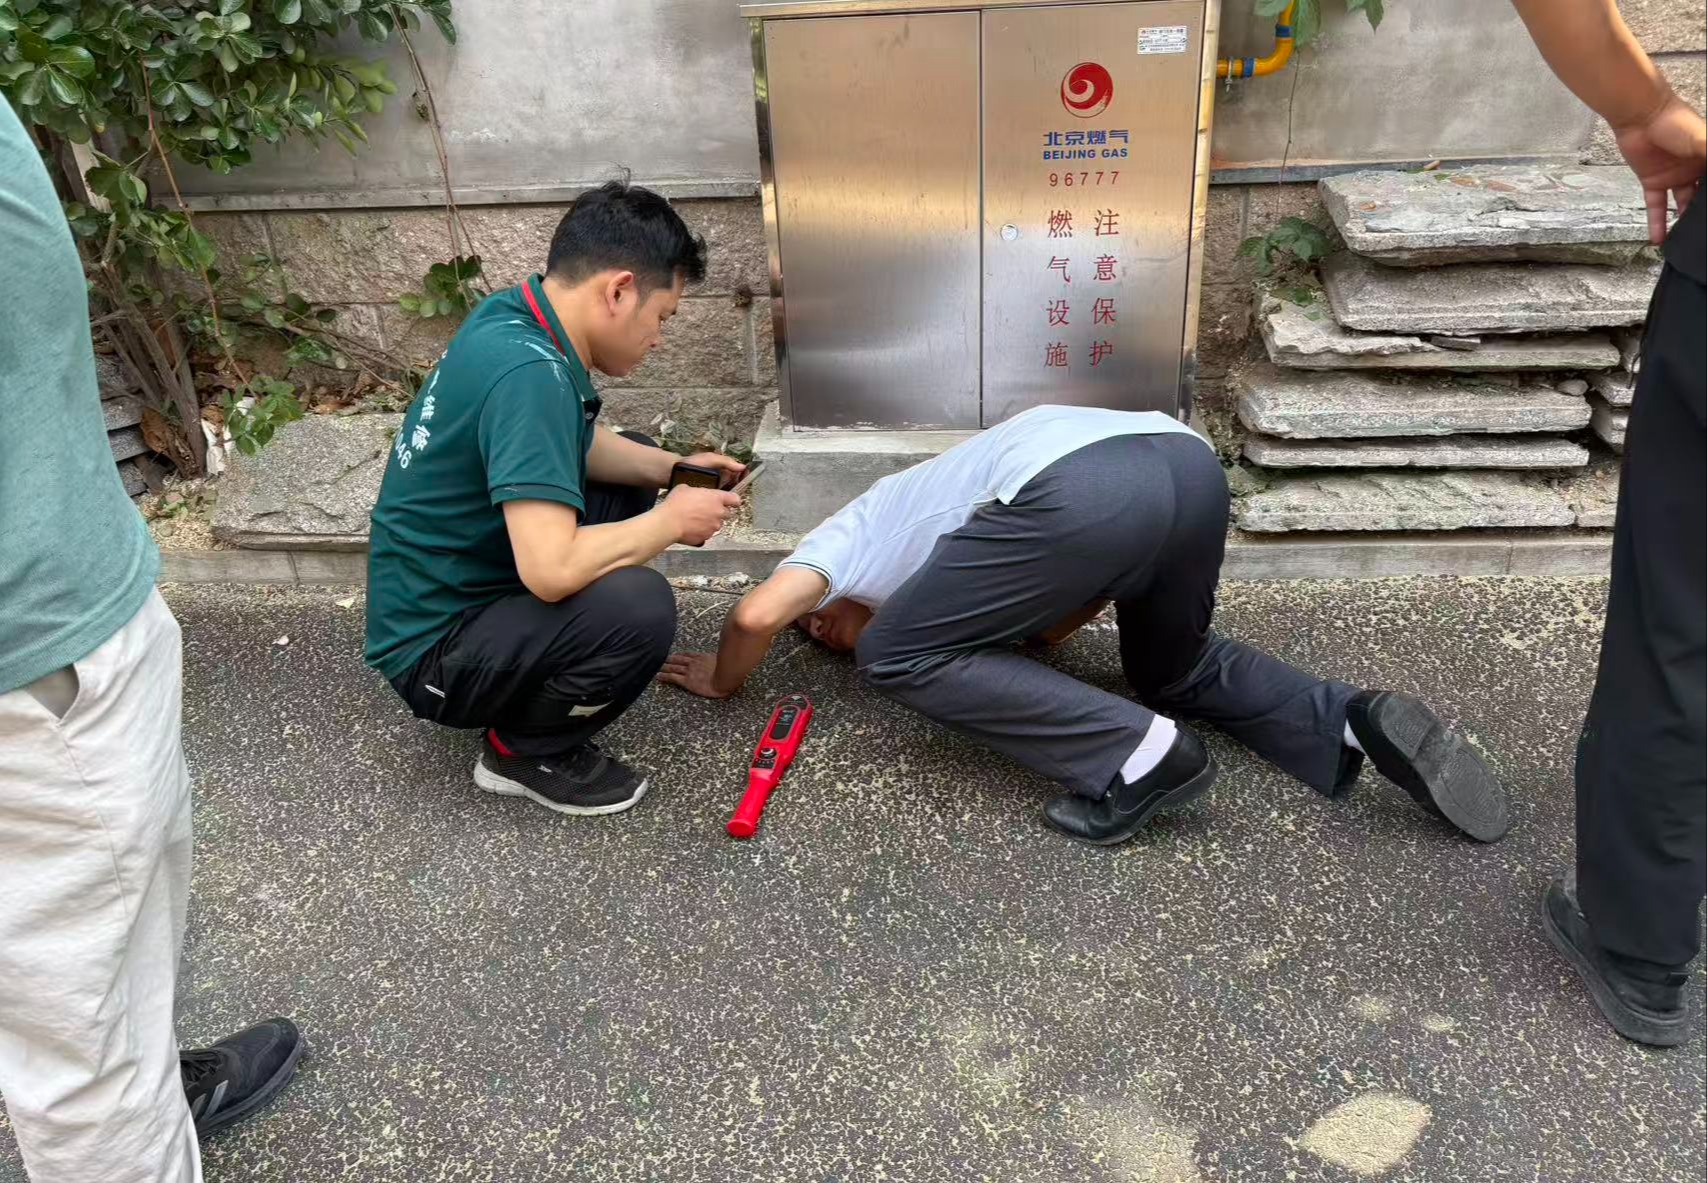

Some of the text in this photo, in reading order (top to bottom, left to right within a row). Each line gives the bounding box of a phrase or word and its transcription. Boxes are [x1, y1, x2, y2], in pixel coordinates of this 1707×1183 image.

[1043, 130, 1129, 146] 北京燃气
[1043, 148, 1128, 160] BEIJING GAS
[1049, 171, 1120, 187] 96777
[1044, 210, 1073, 368] 燃气设施
[1089, 209, 1119, 368] 注意保护
